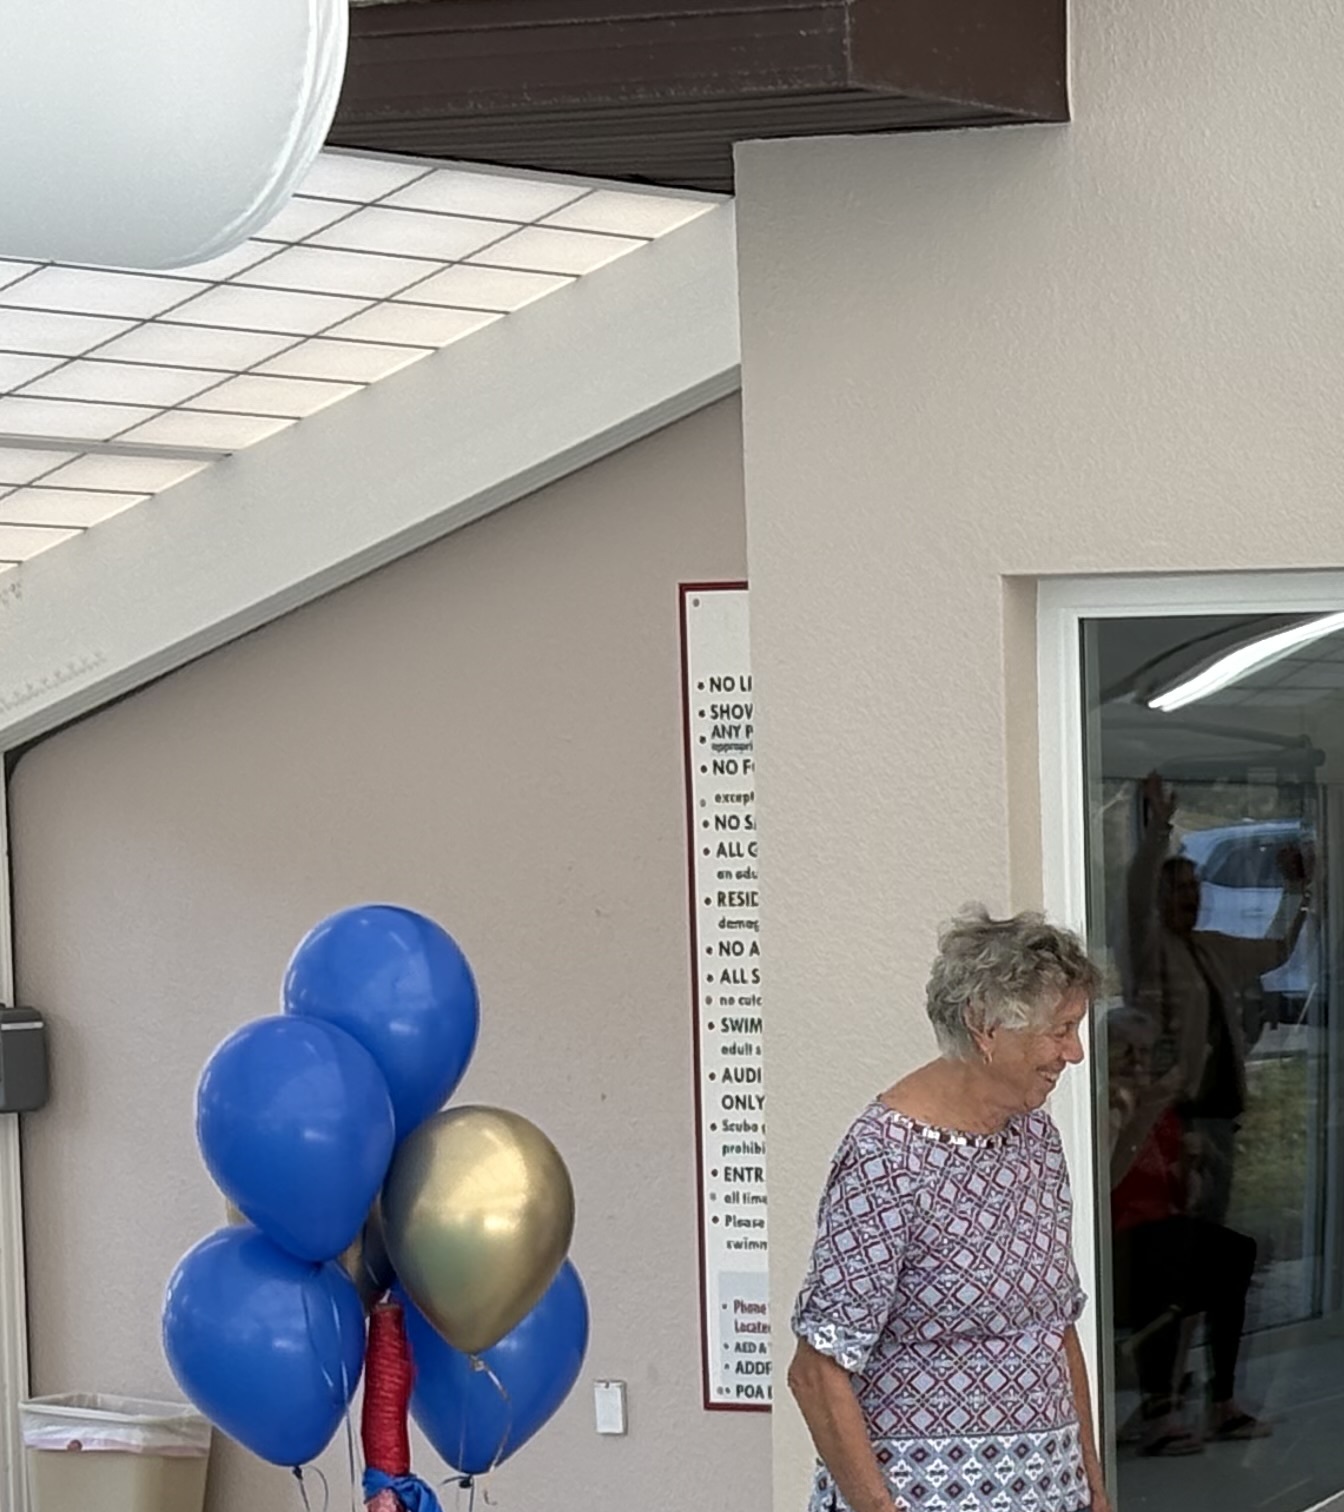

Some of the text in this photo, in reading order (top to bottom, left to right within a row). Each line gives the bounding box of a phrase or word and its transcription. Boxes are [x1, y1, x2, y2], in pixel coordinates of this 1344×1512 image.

[709, 676, 735, 693] NO
[711, 724, 741, 739] ANY
[713, 759, 738, 775] NO
[715, 814, 740, 831] NO
[717, 841, 744, 858] ALL
[719, 941, 744, 956] NO
[720, 968, 747, 984] ALL
[722, 1067, 761, 1083] AUDI
[721, 1094, 765, 1110] ONLY
[725, 1214, 765, 1229] Please
